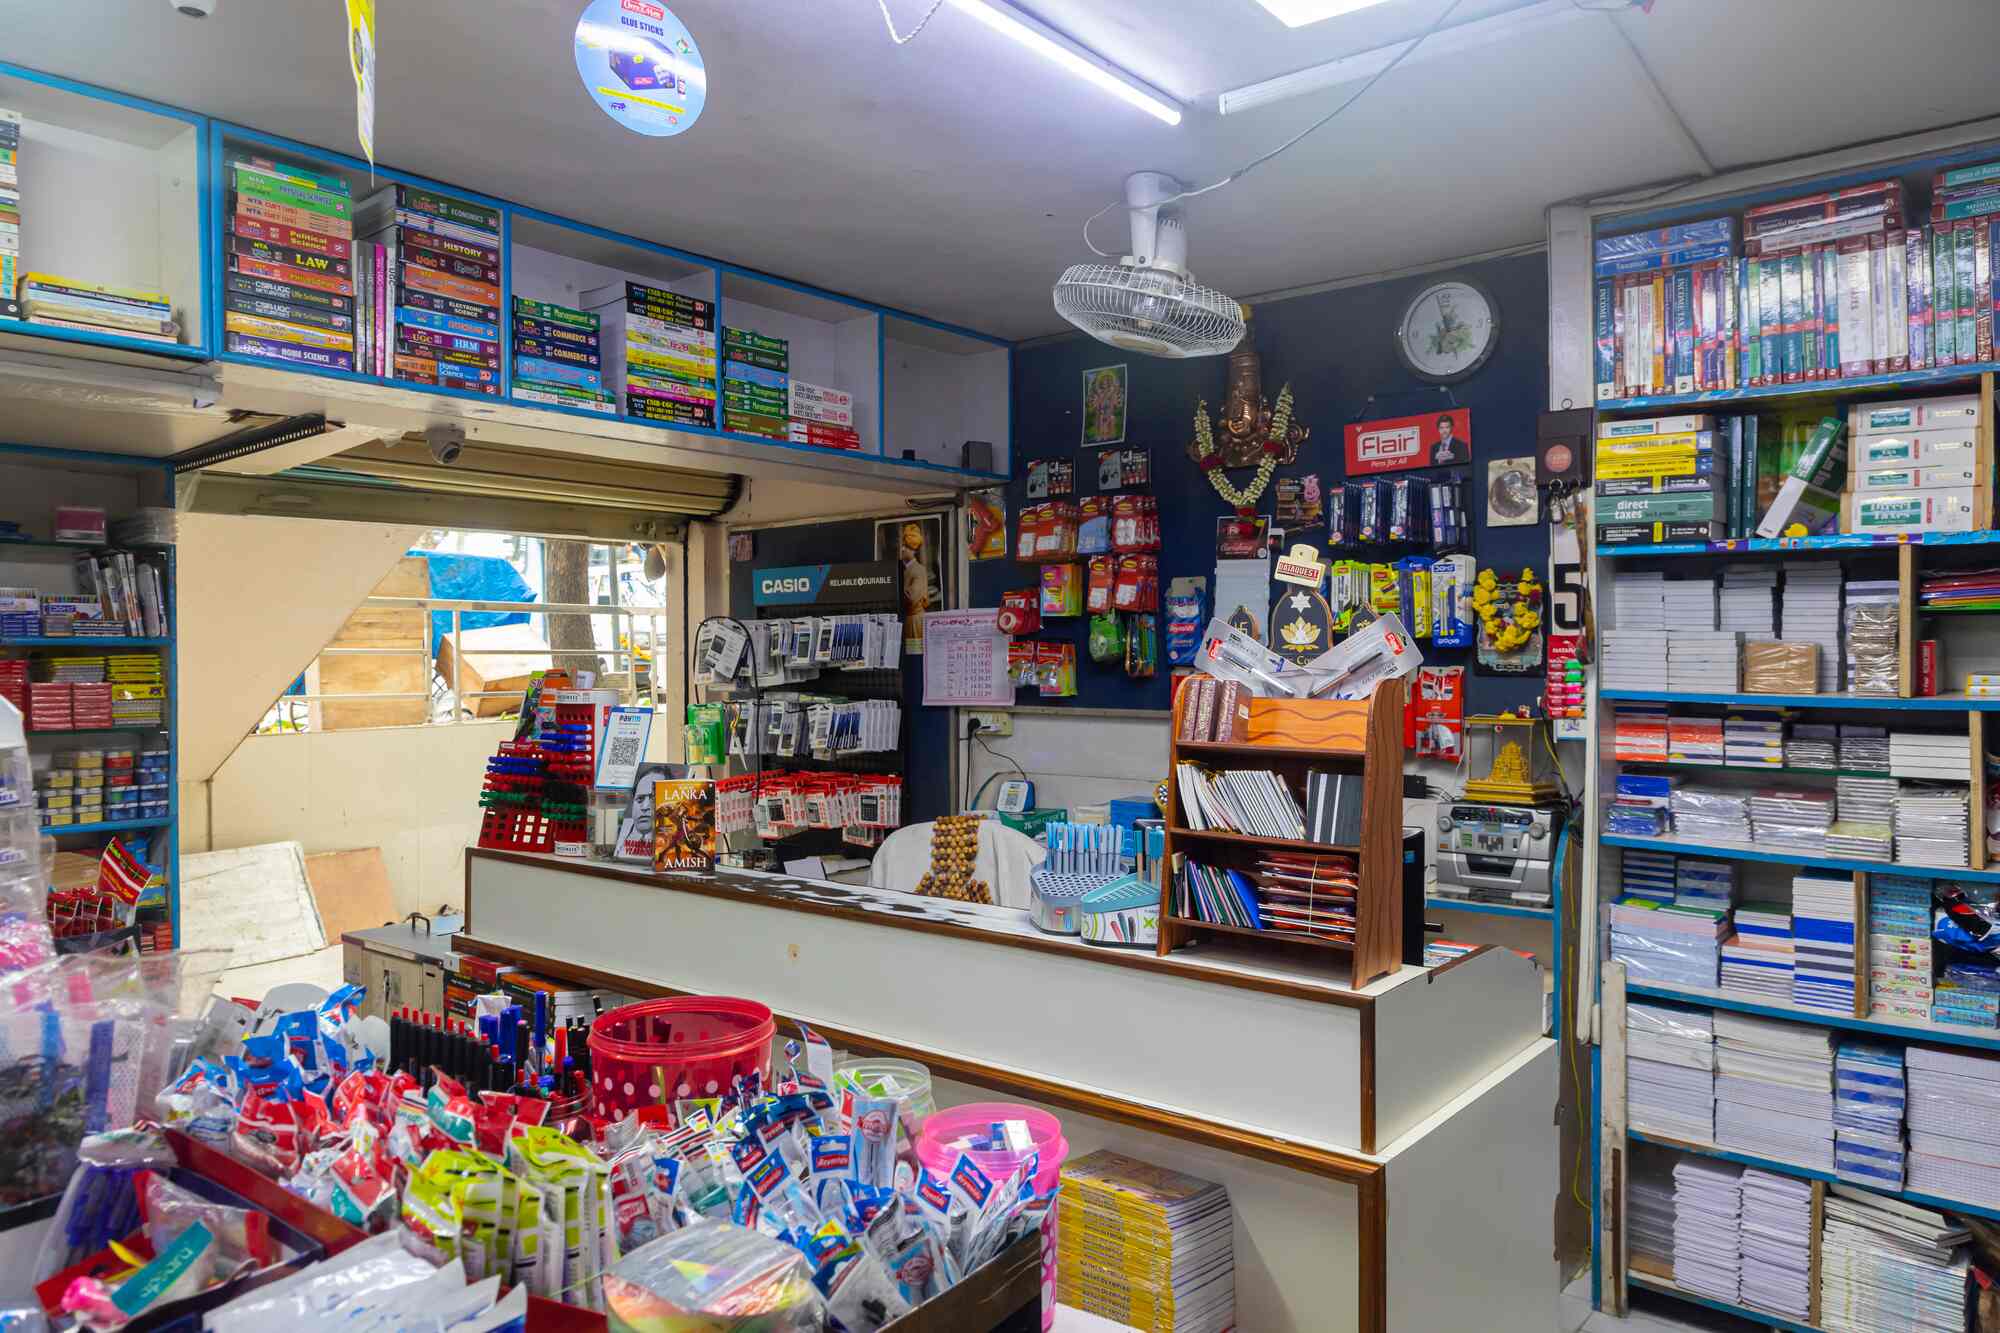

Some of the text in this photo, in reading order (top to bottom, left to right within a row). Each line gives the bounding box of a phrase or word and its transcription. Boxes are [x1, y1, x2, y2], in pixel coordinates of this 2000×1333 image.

[621, 16, 664, 36] GLUE STICKS
[443, 240, 482, 257] HISTORY
[295, 254, 329, 271] LAW
[412, 333, 480, 352] UGC HRM
[552, 329, 587, 343] COMMERCE
[303, 351, 329, 363] SCIENCE
[553, 349, 588, 362] COMMERCE
[1362, 434, 1416, 456] Flair
[1617, 500, 1649, 510] direct
[1614, 510, 1643, 520] taxes
[762, 576, 892, 594] CASIO RELIABLE DURABLE
[1554, 563, 1587, 630] 5
[664, 789, 708, 801] LANKA
[664, 857, 707, 869] AMISH
